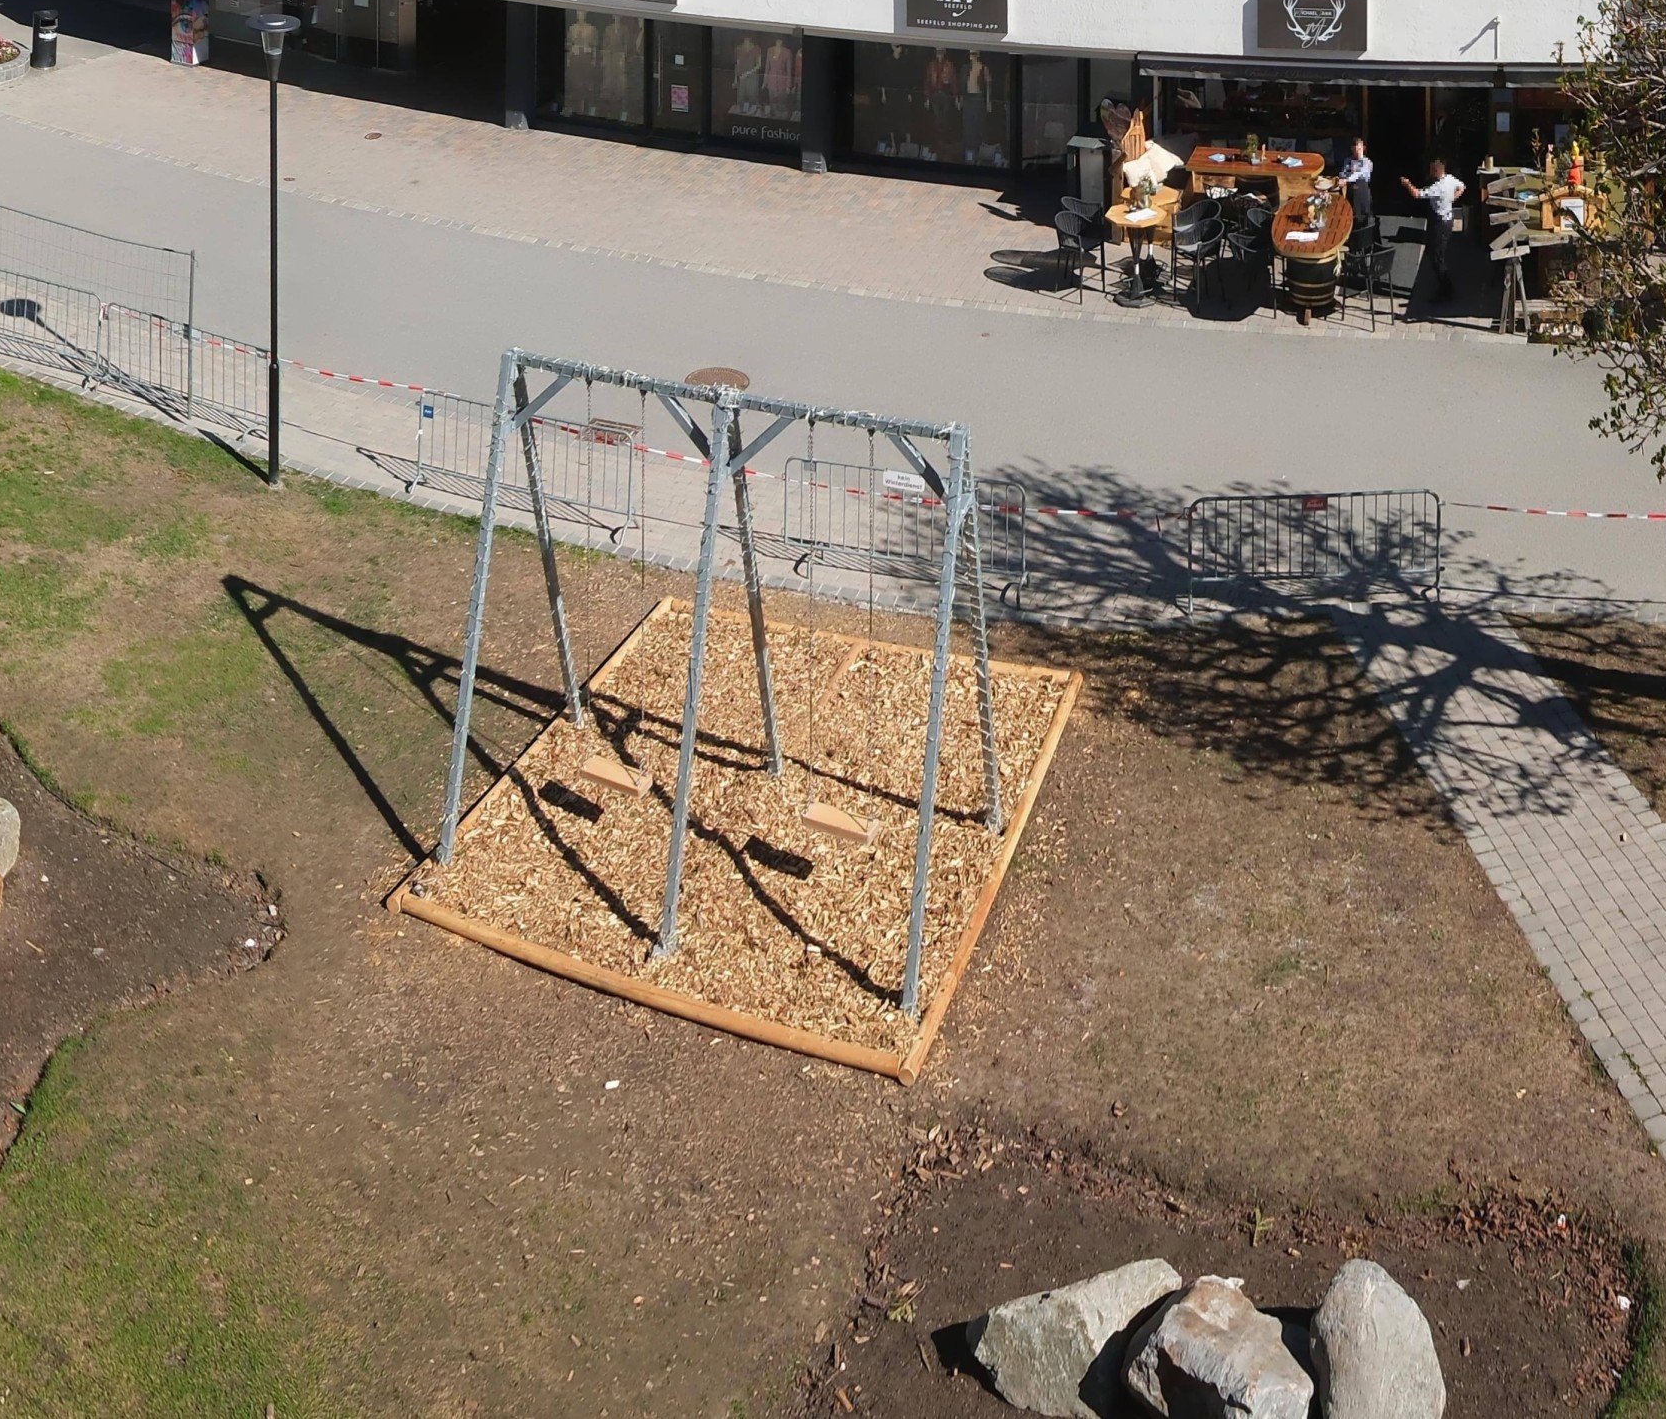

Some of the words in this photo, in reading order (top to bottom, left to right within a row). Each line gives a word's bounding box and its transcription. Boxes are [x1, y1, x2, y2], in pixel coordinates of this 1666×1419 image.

[948, 21, 983, 29] SHOPPING
[732, 125, 758, 136] pure
[897, 474, 911, 482] kein
[885, 479, 923, 490] Winterdienst
